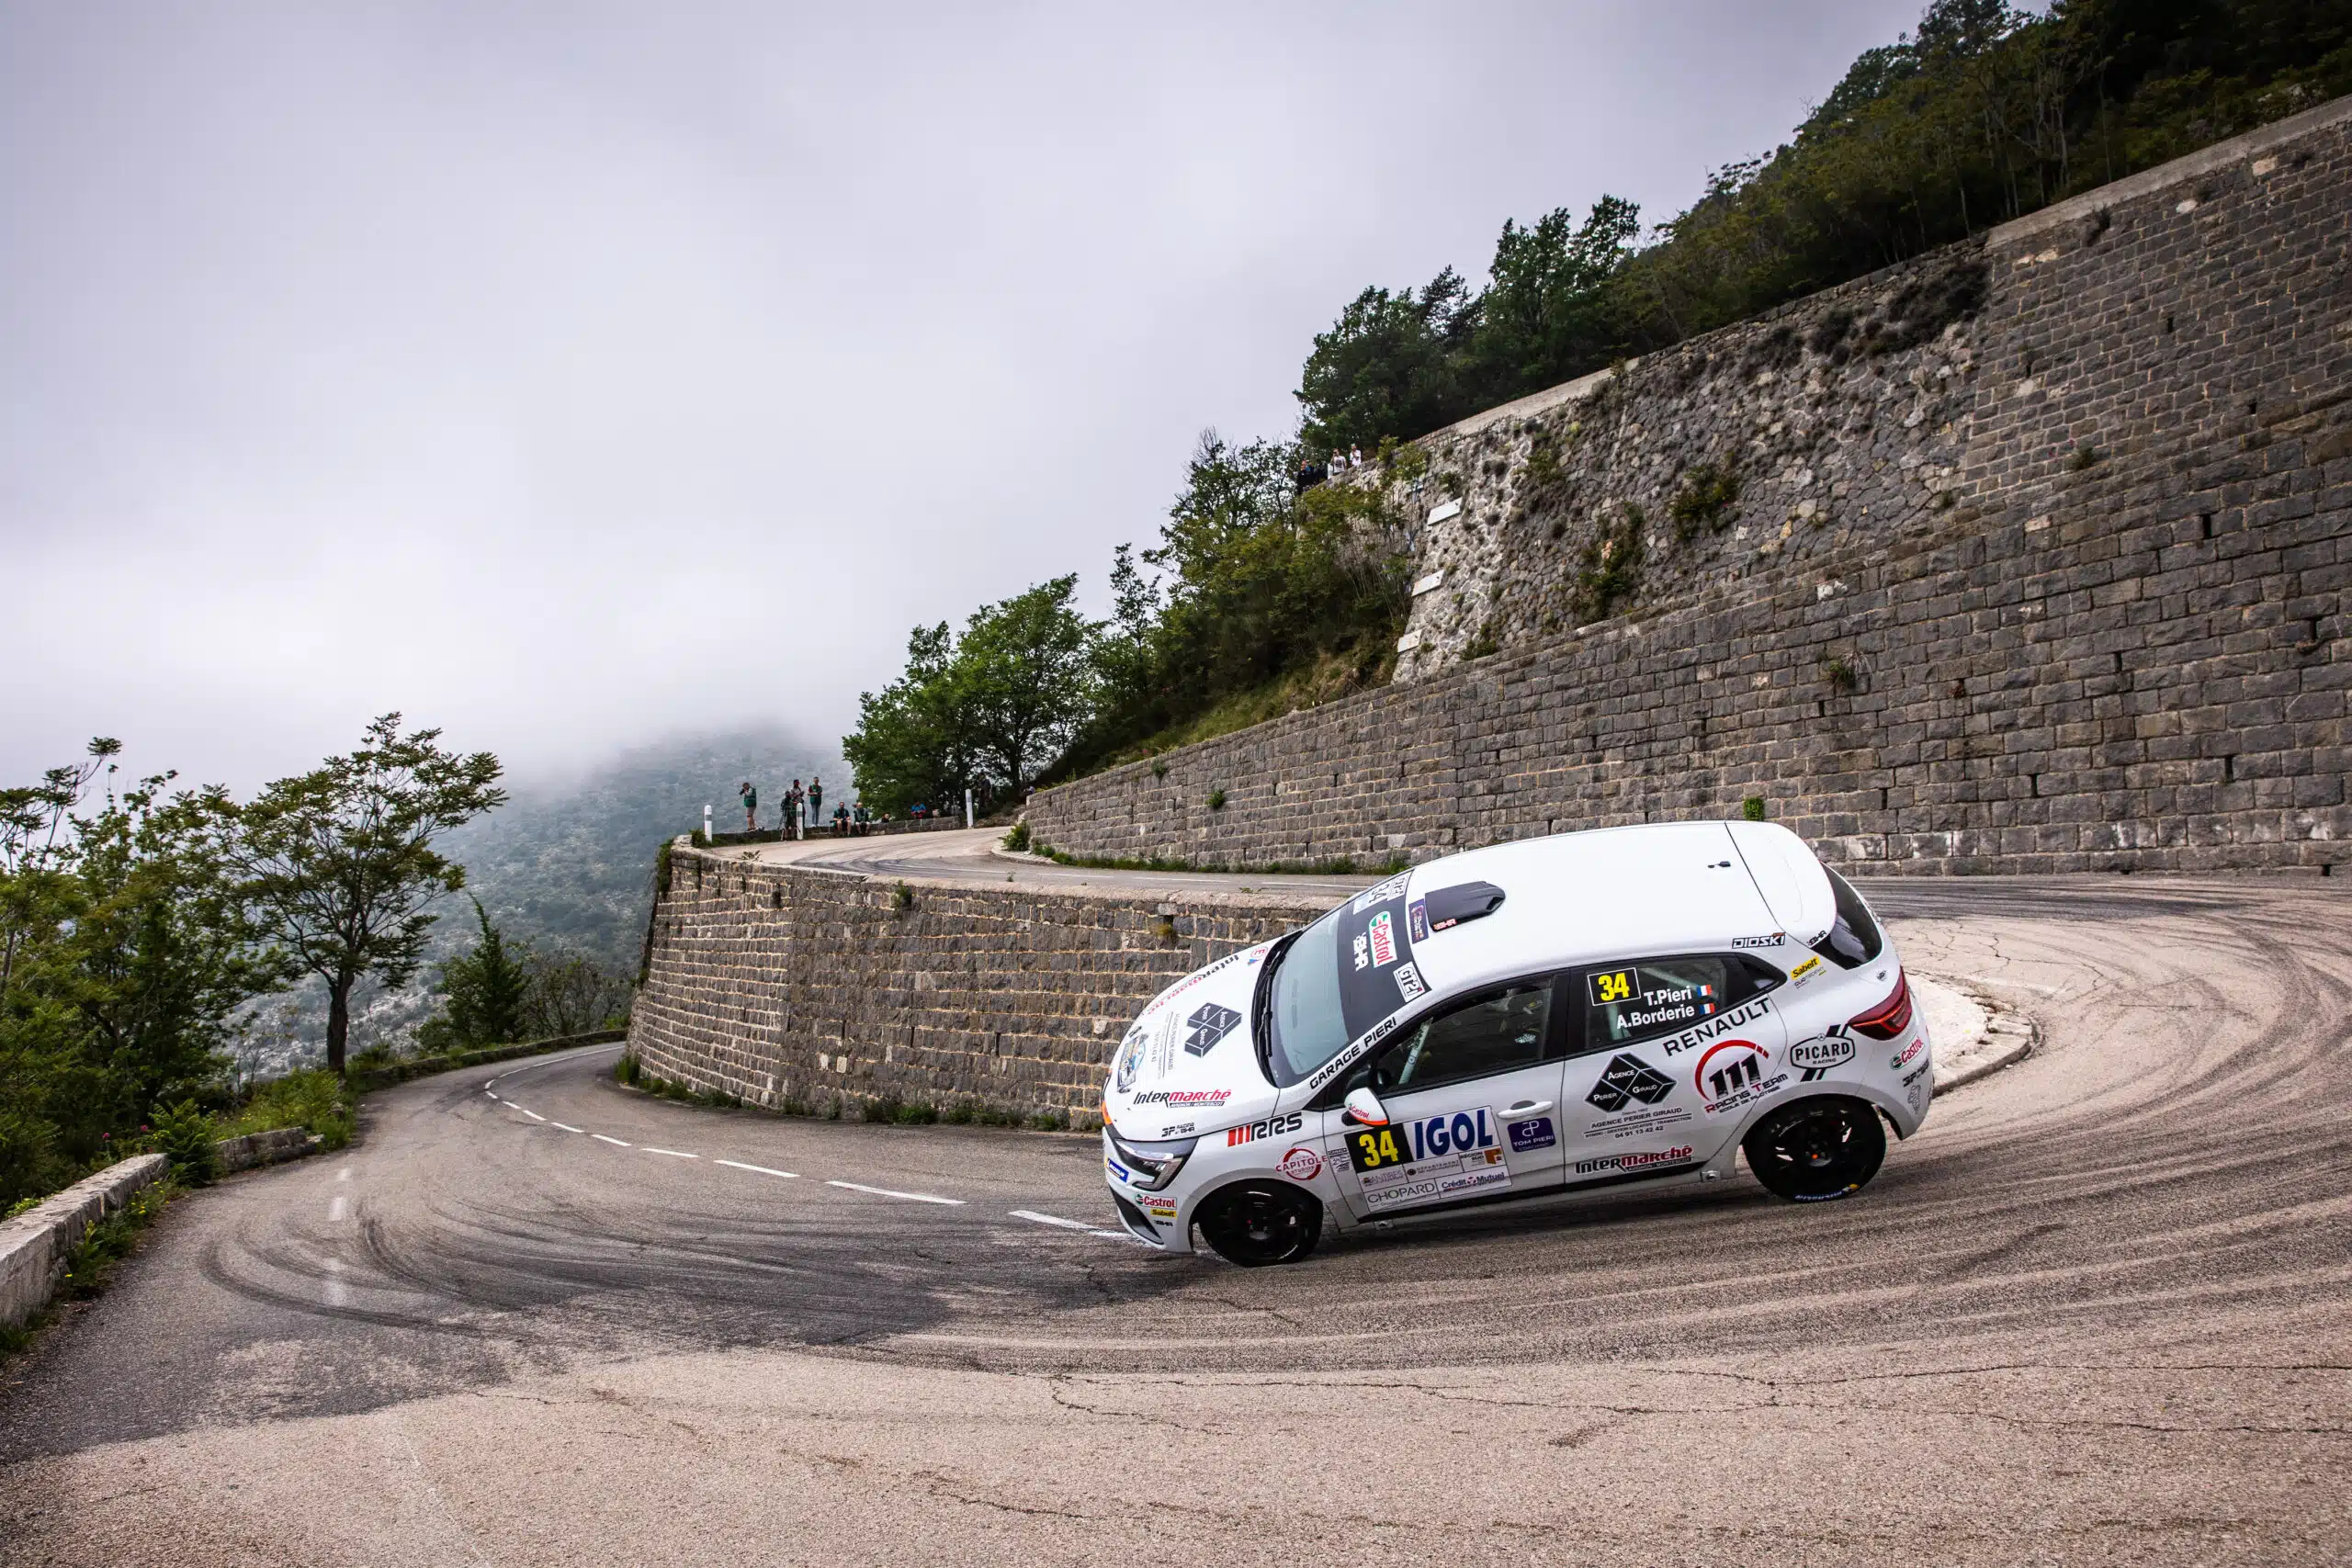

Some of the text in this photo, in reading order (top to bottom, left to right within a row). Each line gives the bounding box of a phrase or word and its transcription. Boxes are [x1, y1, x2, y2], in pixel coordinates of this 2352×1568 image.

[1372, 922, 1394, 965] Castrol
[1792, 958, 1818, 978] Sabelt
[1598, 972, 1630, 1001] 34
[1644, 986, 1692, 1007] T.Pieri
[1616, 1004, 1695, 1030] A.Borderie
[1663, 997, 1770, 1056] RENAULT
[1309, 1017, 1396, 1089] GARAGE PIERI
[1795, 1042, 1850, 1061] PICARD
[1709, 1053, 1761, 1100] 111
[1704, 1089, 1752, 1113] RACING
[1250, 1111, 1303, 1142] RRS
[1591, 1107, 1682, 1129] AGENCE PERIER GIRAUD
[1415, 1109, 1493, 1159] IGOL
[1533, 1135, 1554, 1144] PIERI
[1359, 1130, 1399, 1168] 34
[1275, 1155, 1328, 1172] CAPITOLE
[1476, 1171, 1505, 1185] Mutuel
[1144, 1195, 1175, 1208] Castrol
[1367, 1182, 1435, 1203] CHOPARD
